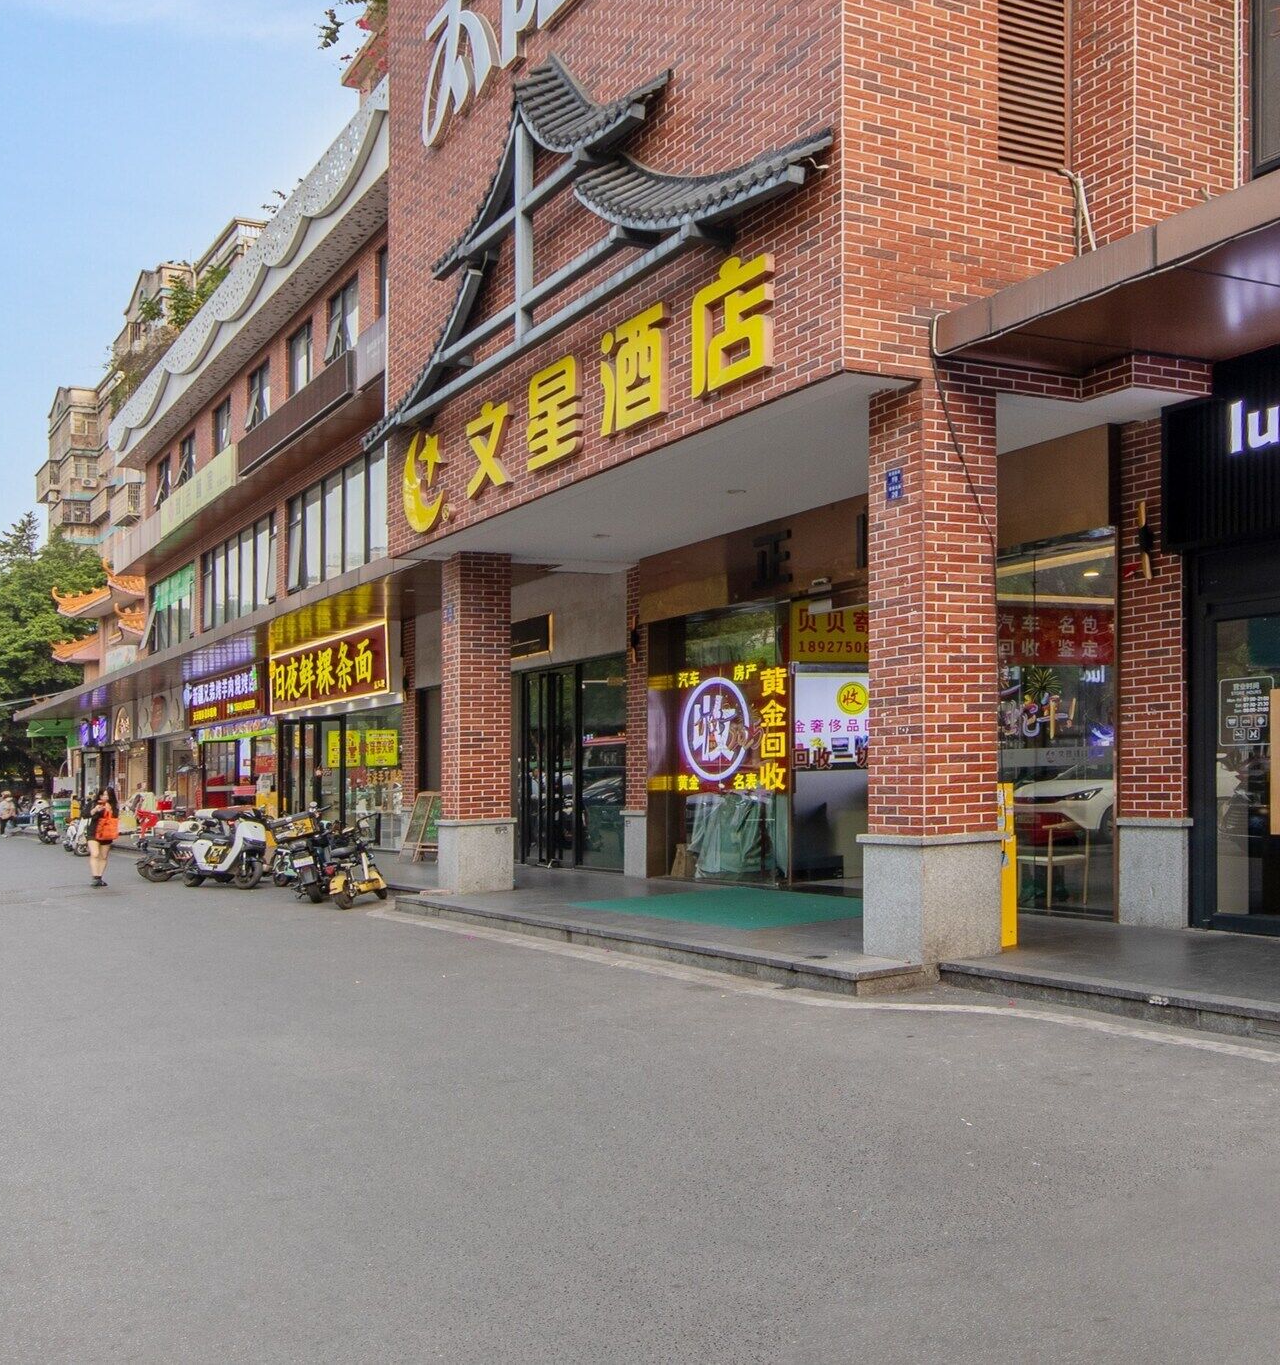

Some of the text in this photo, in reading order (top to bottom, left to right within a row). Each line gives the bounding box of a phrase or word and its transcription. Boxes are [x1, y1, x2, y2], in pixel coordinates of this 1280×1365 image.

[465, 252, 775, 501] 文星酒店
[999, 639, 1040, 657] 回收
[678, 671, 700, 688] 汽车
[733, 664, 758, 681] 房产
[693, 695, 736, 761] 收
[759, 667, 787, 790] 黄金回收
[678, 775, 700, 791] 黄金
[733, 773, 758, 790] 名表
